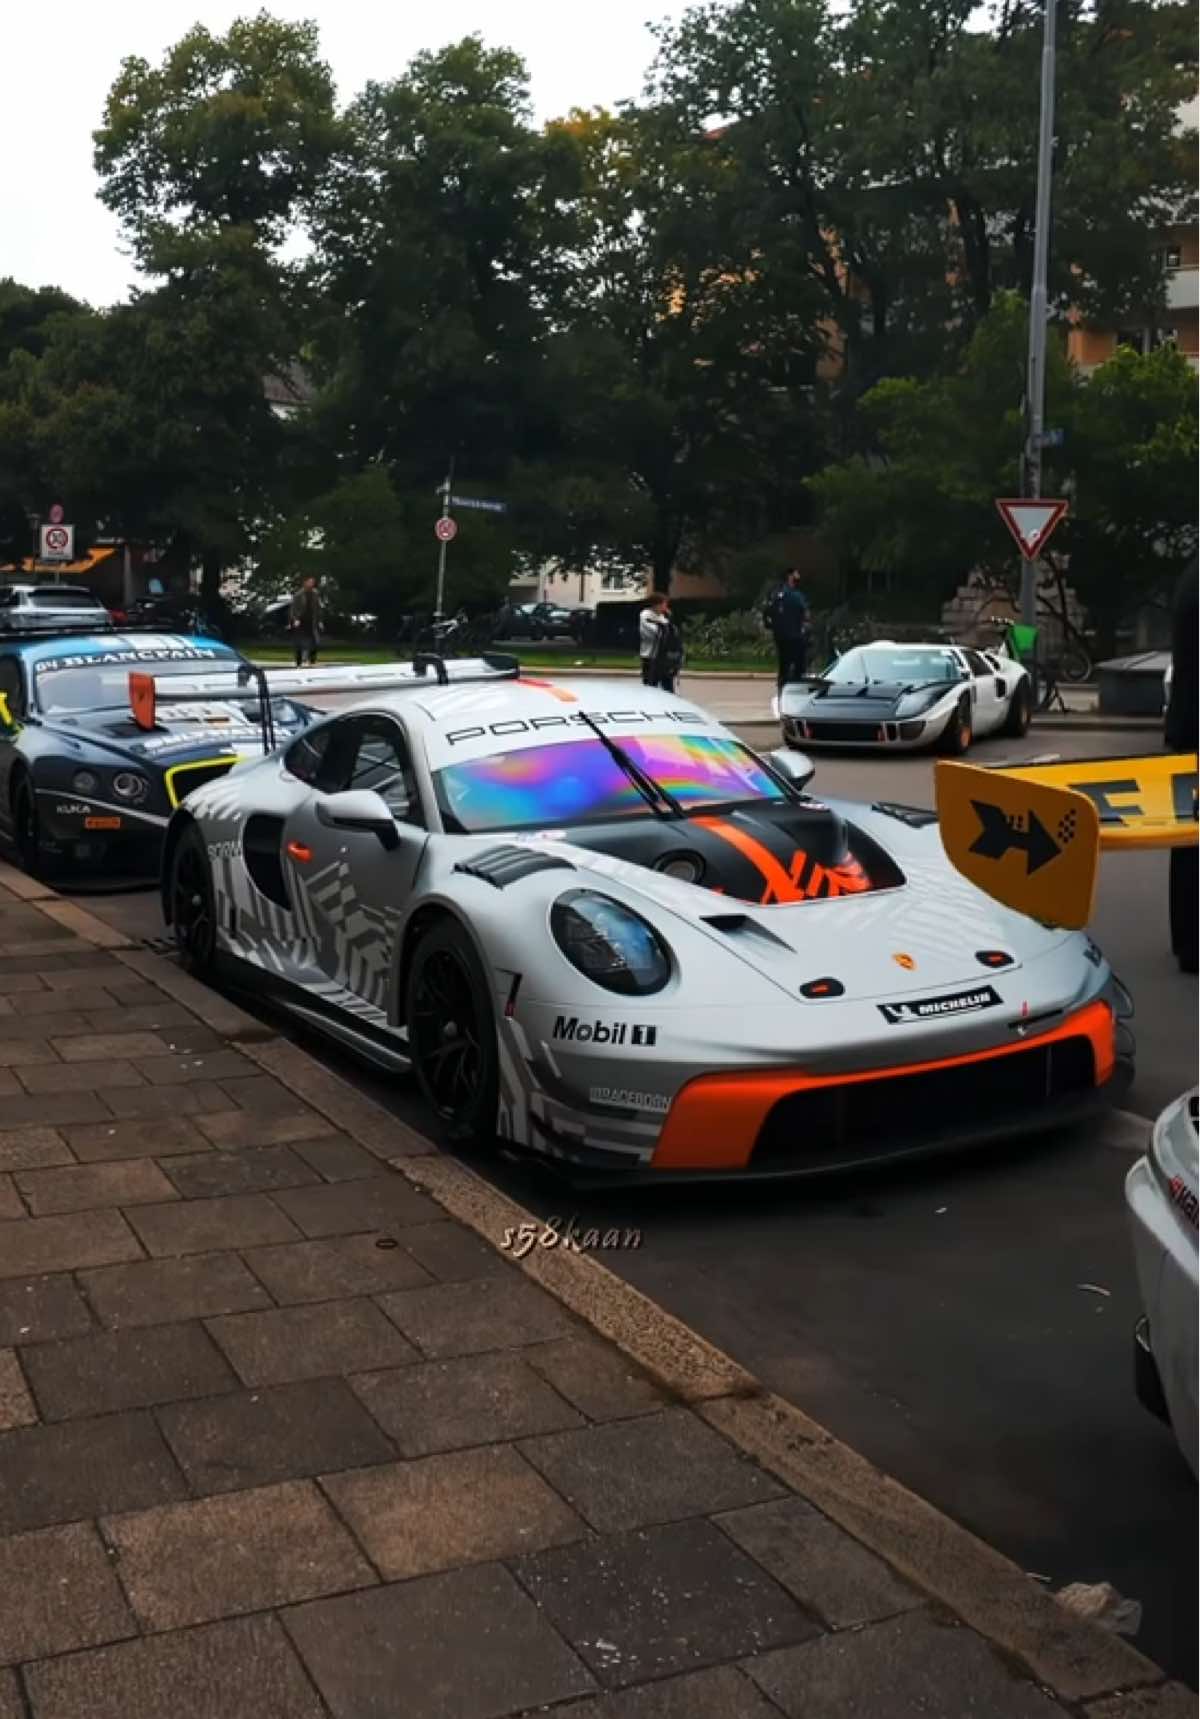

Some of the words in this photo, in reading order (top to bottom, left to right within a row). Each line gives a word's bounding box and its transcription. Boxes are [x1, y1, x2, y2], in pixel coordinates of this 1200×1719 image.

[445, 710, 708, 746] PORSCHE
[919, 992, 992, 1014] MICHELIN
[553, 1015, 627, 1045] Mobil
